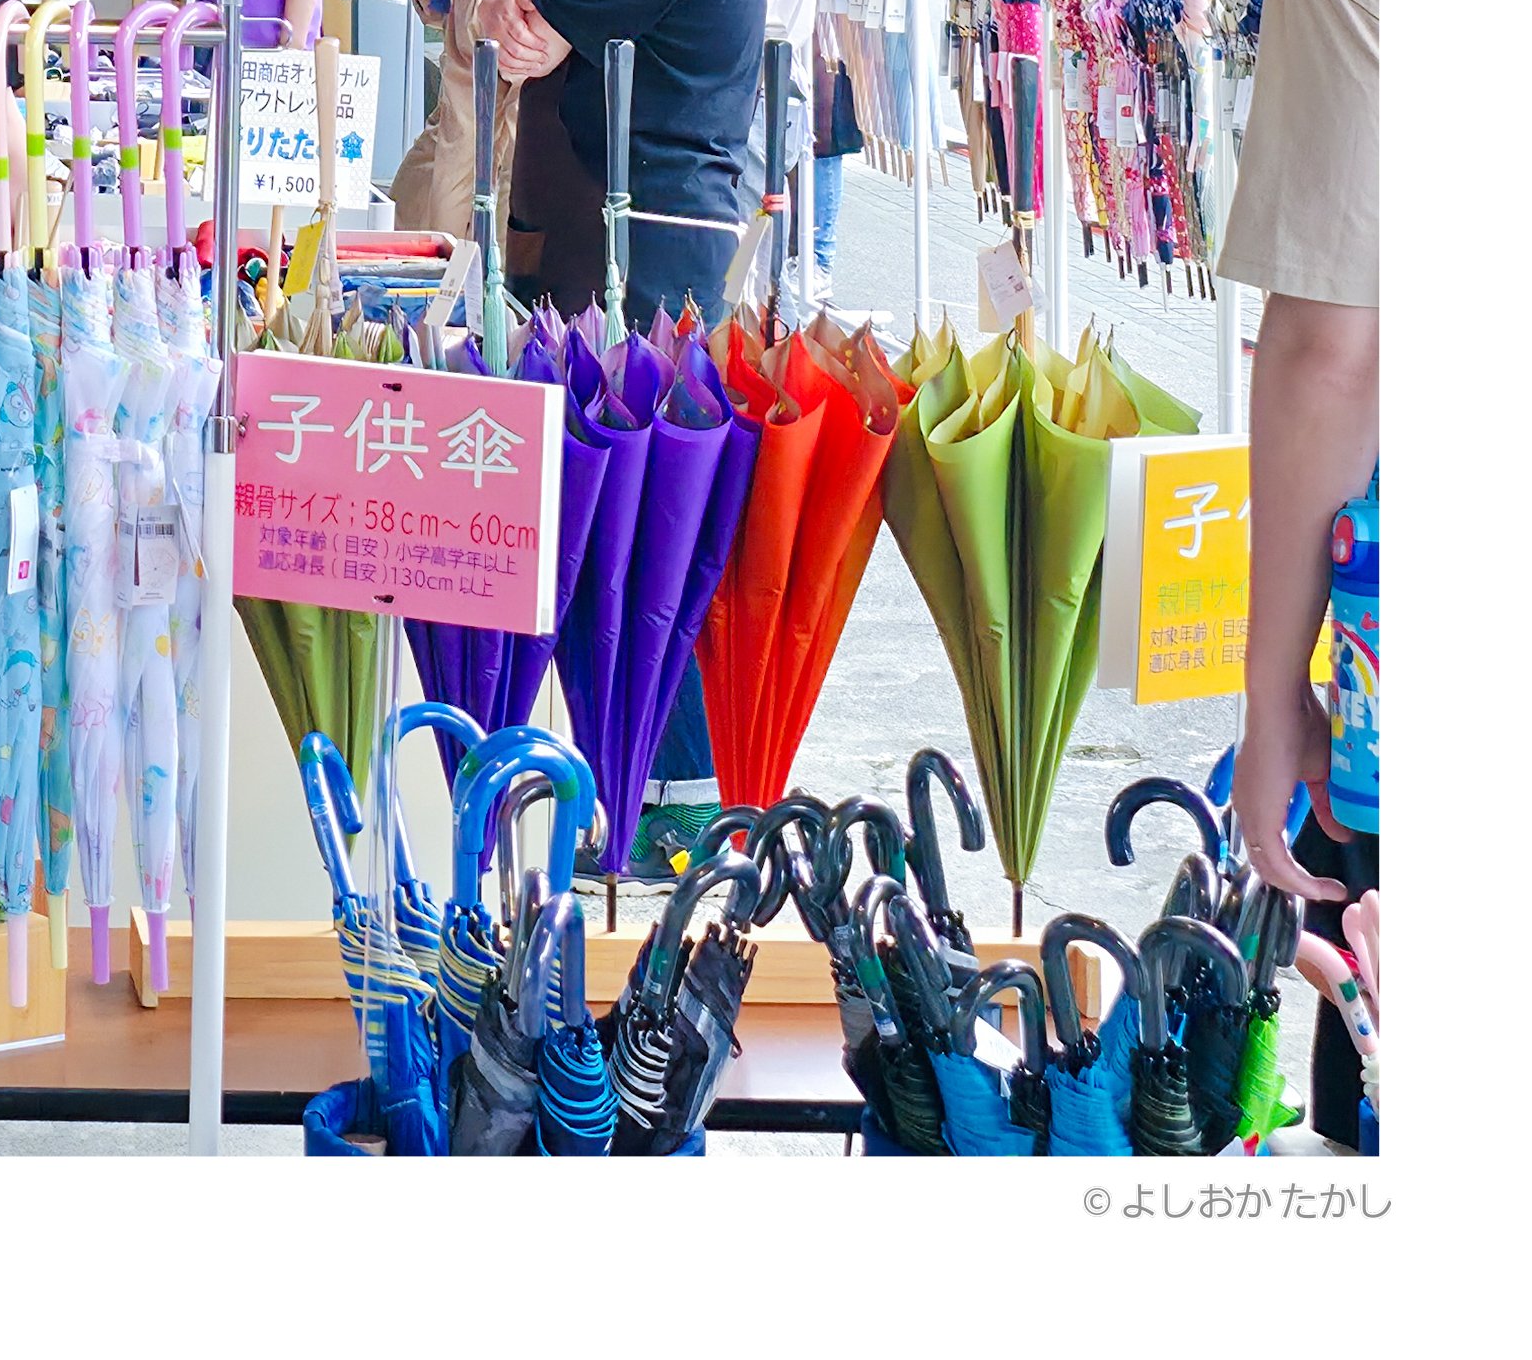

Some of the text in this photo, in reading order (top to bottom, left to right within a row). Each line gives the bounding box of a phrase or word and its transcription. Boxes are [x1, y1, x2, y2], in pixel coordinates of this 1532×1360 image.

[241, 60, 369, 88] 田商店オリナル
[240, 88, 355, 120] アウトレッ品
[240, 126, 364, 164] りたた傘
[254, 173, 315, 194] ¥1,500
[257, 394, 526, 489] 子供傘
